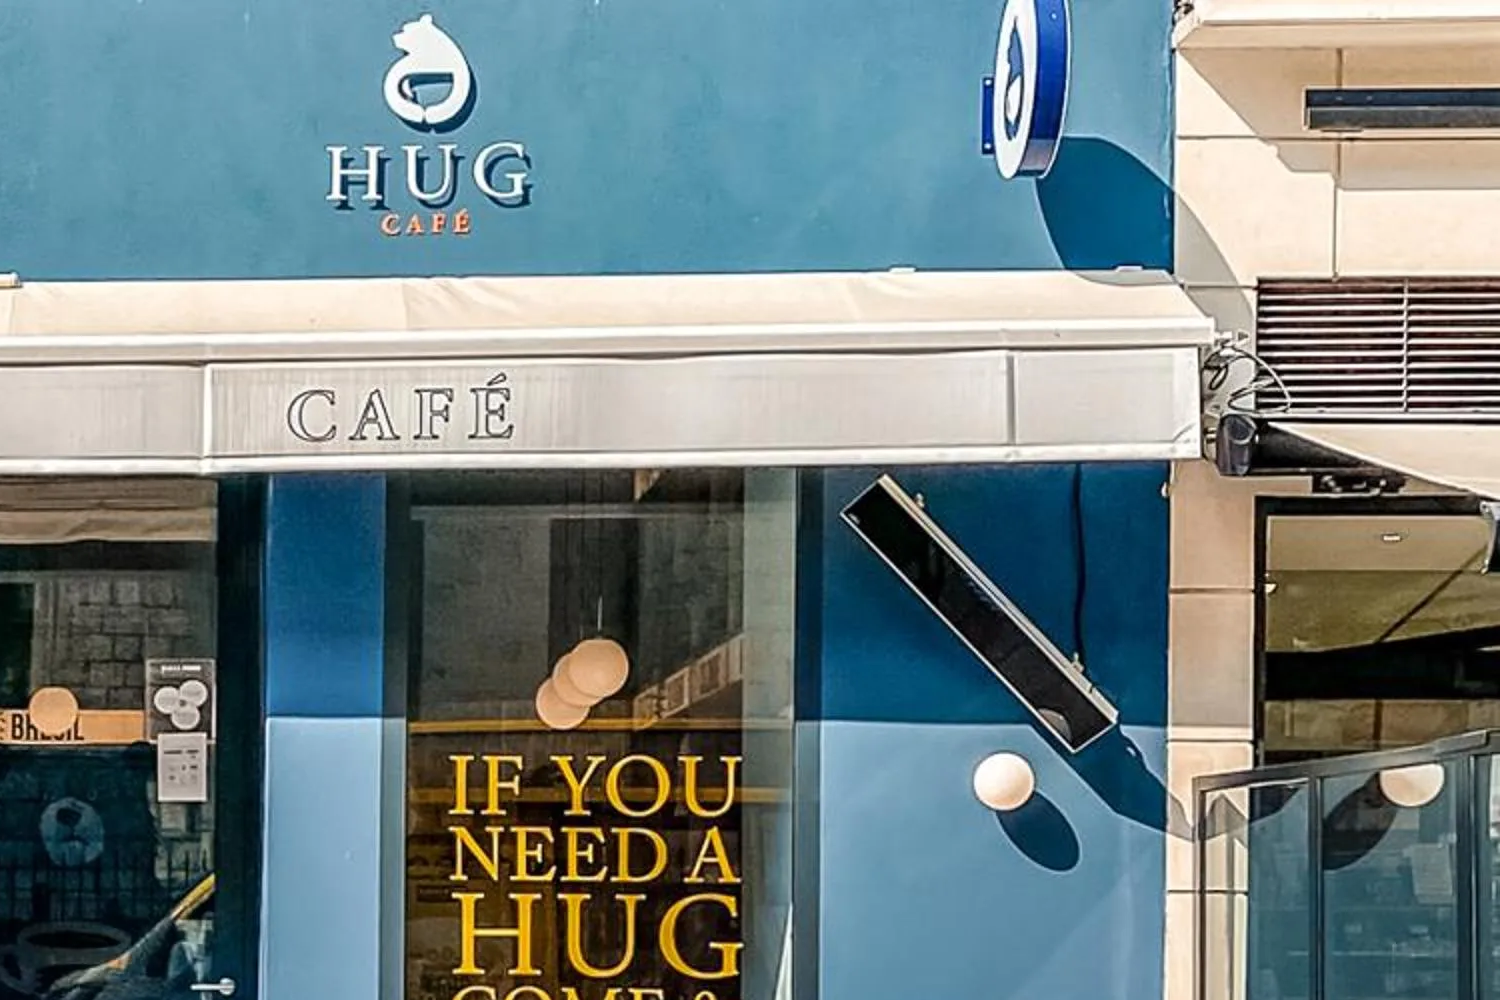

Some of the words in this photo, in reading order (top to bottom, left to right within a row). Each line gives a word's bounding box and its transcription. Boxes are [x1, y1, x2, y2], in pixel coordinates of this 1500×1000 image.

[325, 141, 528, 201] HUG
[380, 209, 472, 235] CAFÉ
[286, 372, 514, 442] CAFÉ
[448, 755, 524, 815] IF
[550, 755, 743, 818] YOU
[448, 826, 669, 882] NEED
[683, 826, 742, 884] A
[451, 893, 745, 980] HUG
